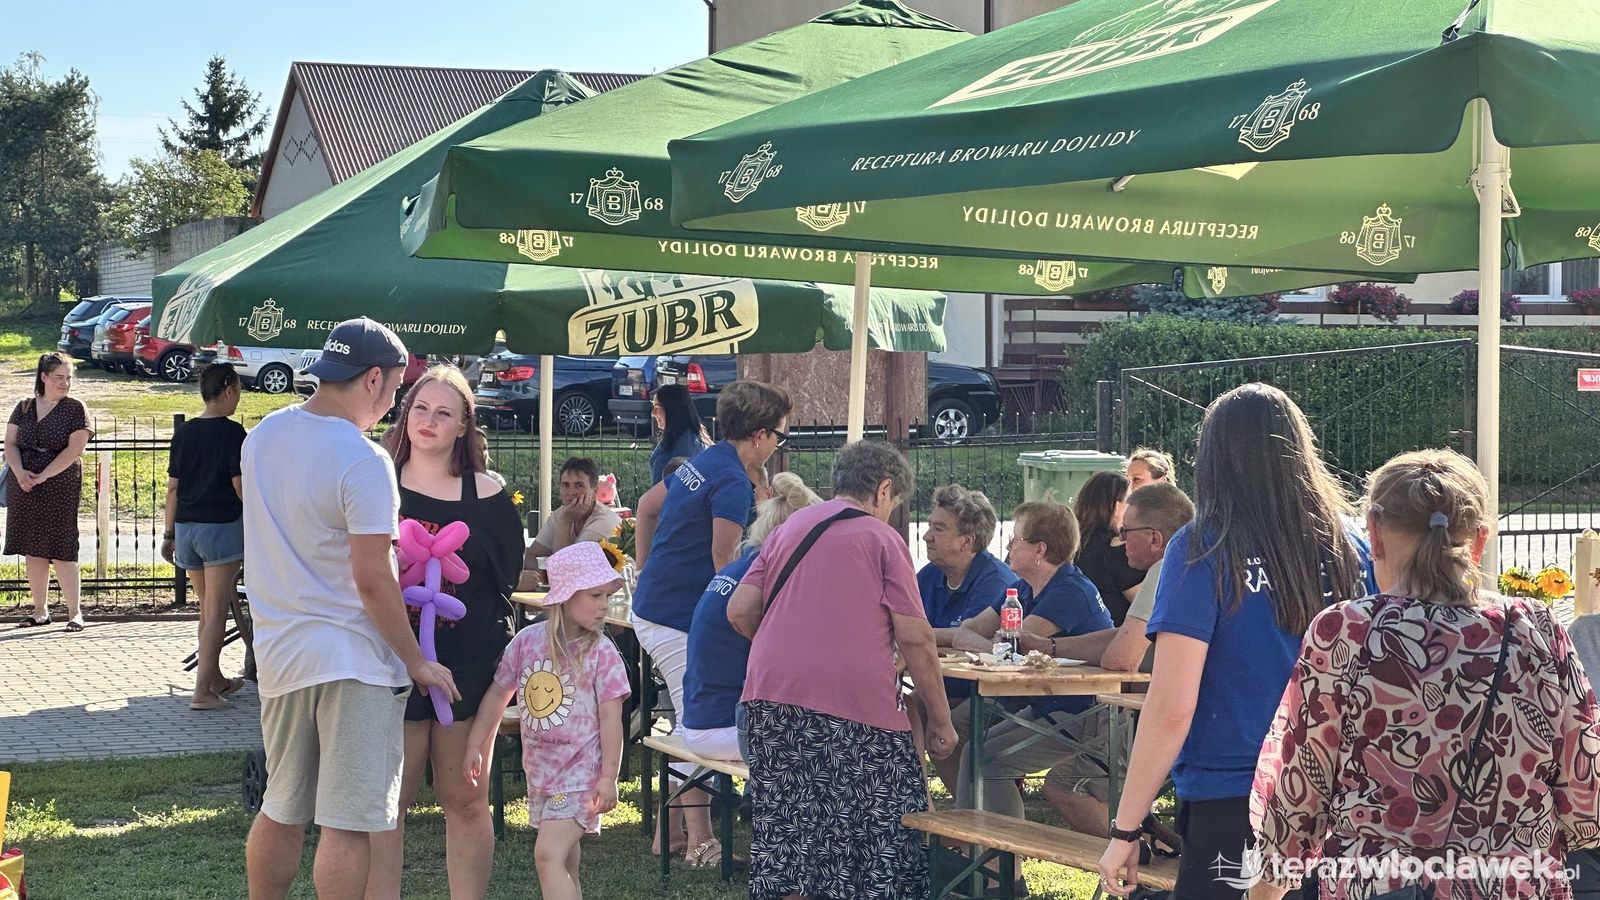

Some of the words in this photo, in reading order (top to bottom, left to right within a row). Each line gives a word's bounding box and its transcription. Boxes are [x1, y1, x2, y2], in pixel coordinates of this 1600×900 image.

[1228, 114, 1247, 129] 17
[1298, 102, 1321, 120] 68
[851, 150, 944, 172] RECEPTURA
[948, 140, 1048, 163] BROWARU
[1049, 129, 1141, 153] DOJLIDY
[718, 171, 731, 185] 17
[765, 165, 783, 178] 68
[569, 192, 584, 205] 17
[644, 197, 664, 211] 68
[238, 317, 249, 327] 17
[283, 318, 297, 329] 68
[423, 323, 468, 336] DOJLIDY
